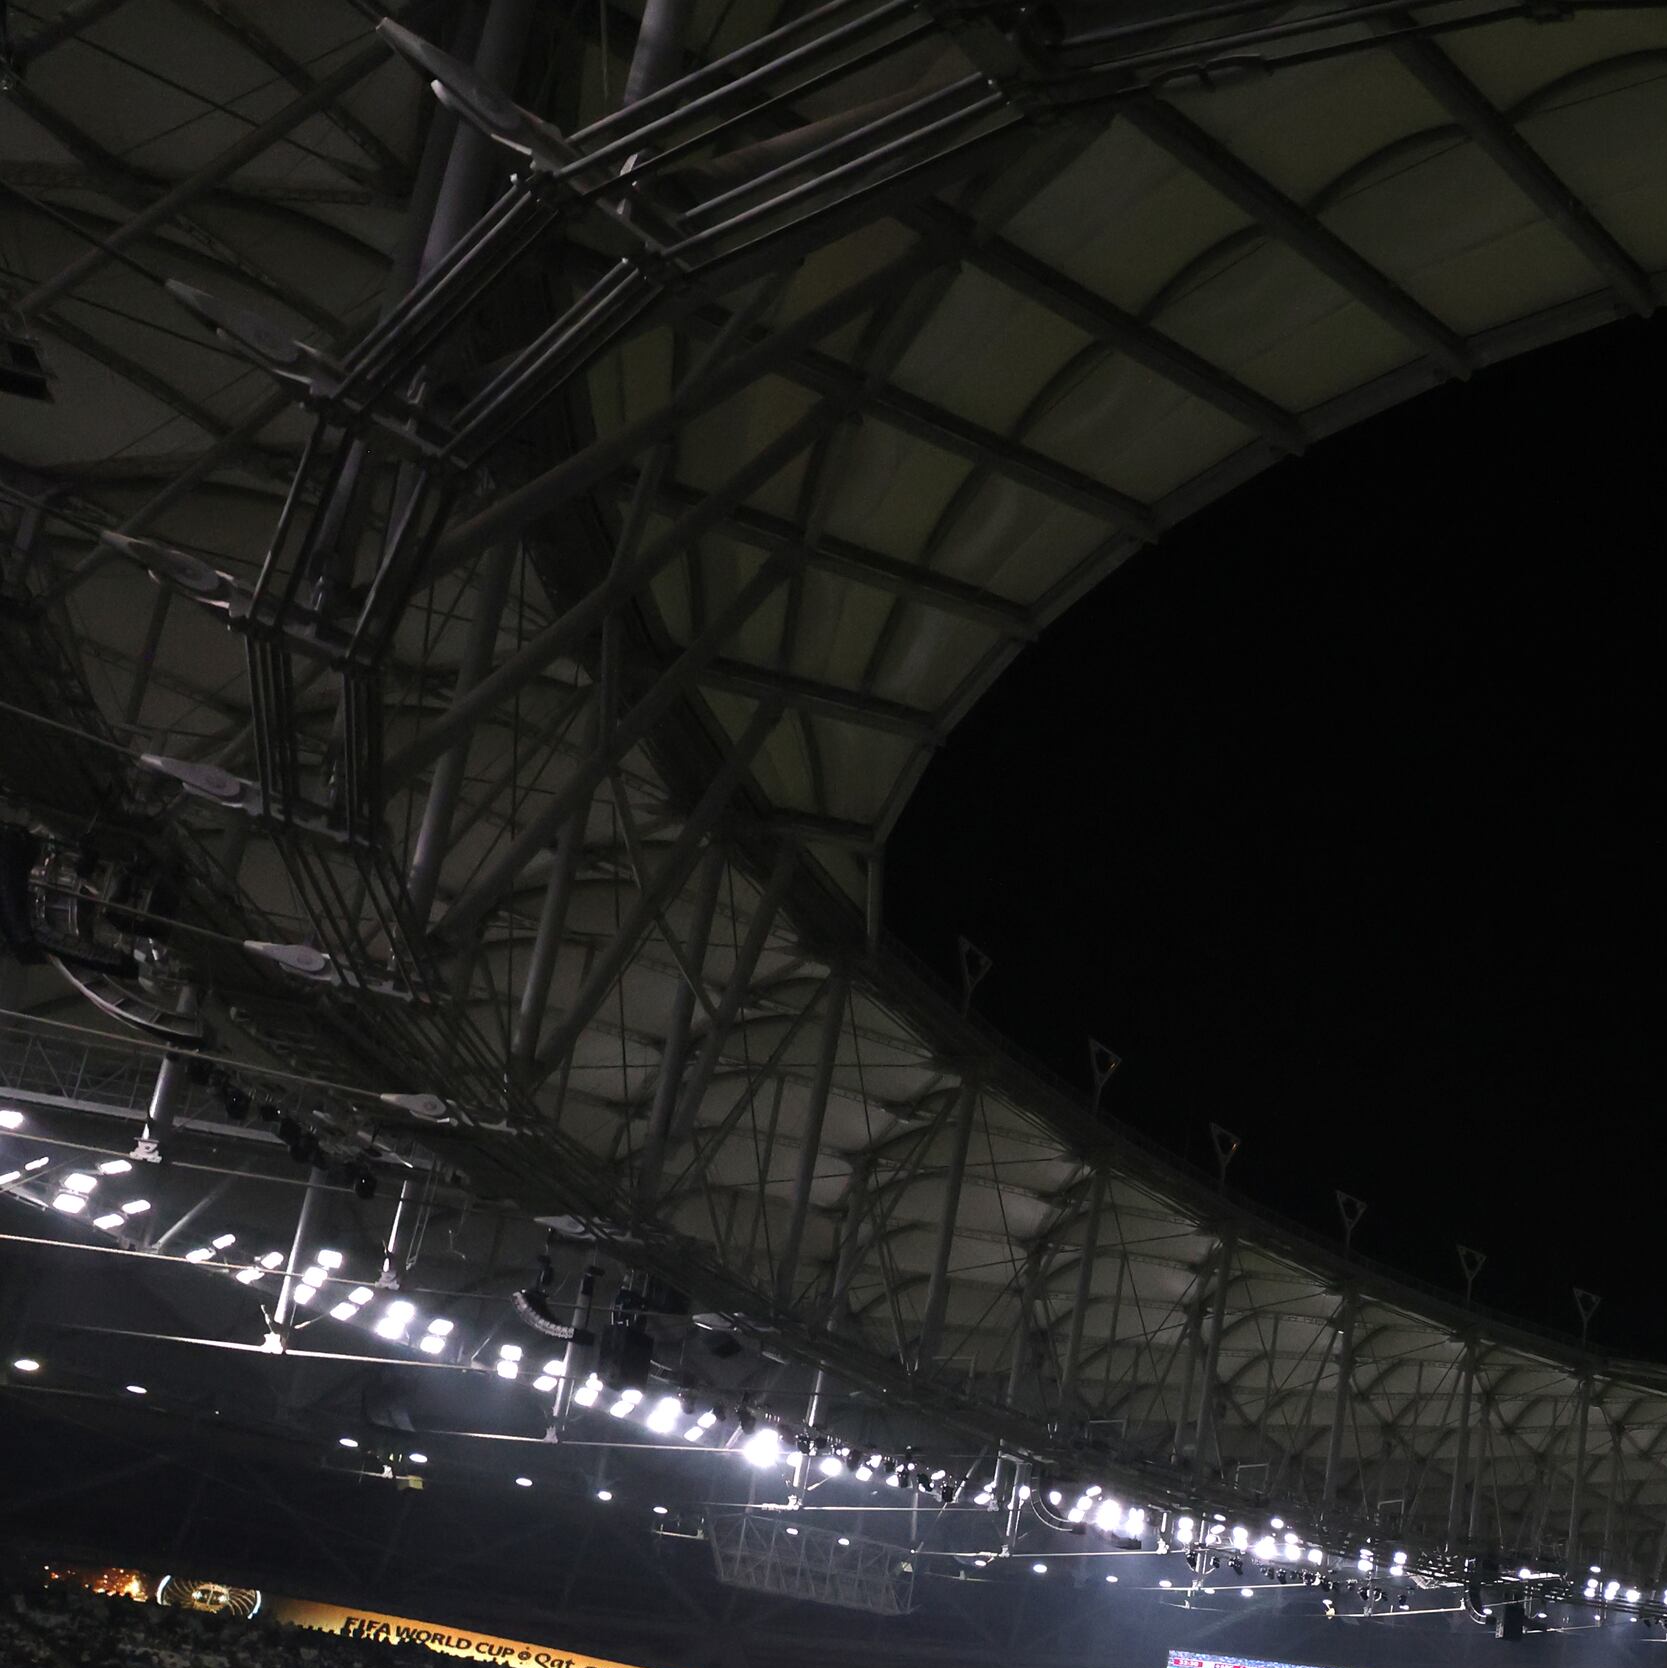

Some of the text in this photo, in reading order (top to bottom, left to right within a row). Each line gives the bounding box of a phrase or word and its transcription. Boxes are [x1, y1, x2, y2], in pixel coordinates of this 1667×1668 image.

[344, 1616, 391, 1637] FIFA
[394, 1626, 472, 1650] WORLD
[475, 1642, 514, 1660] CUP
